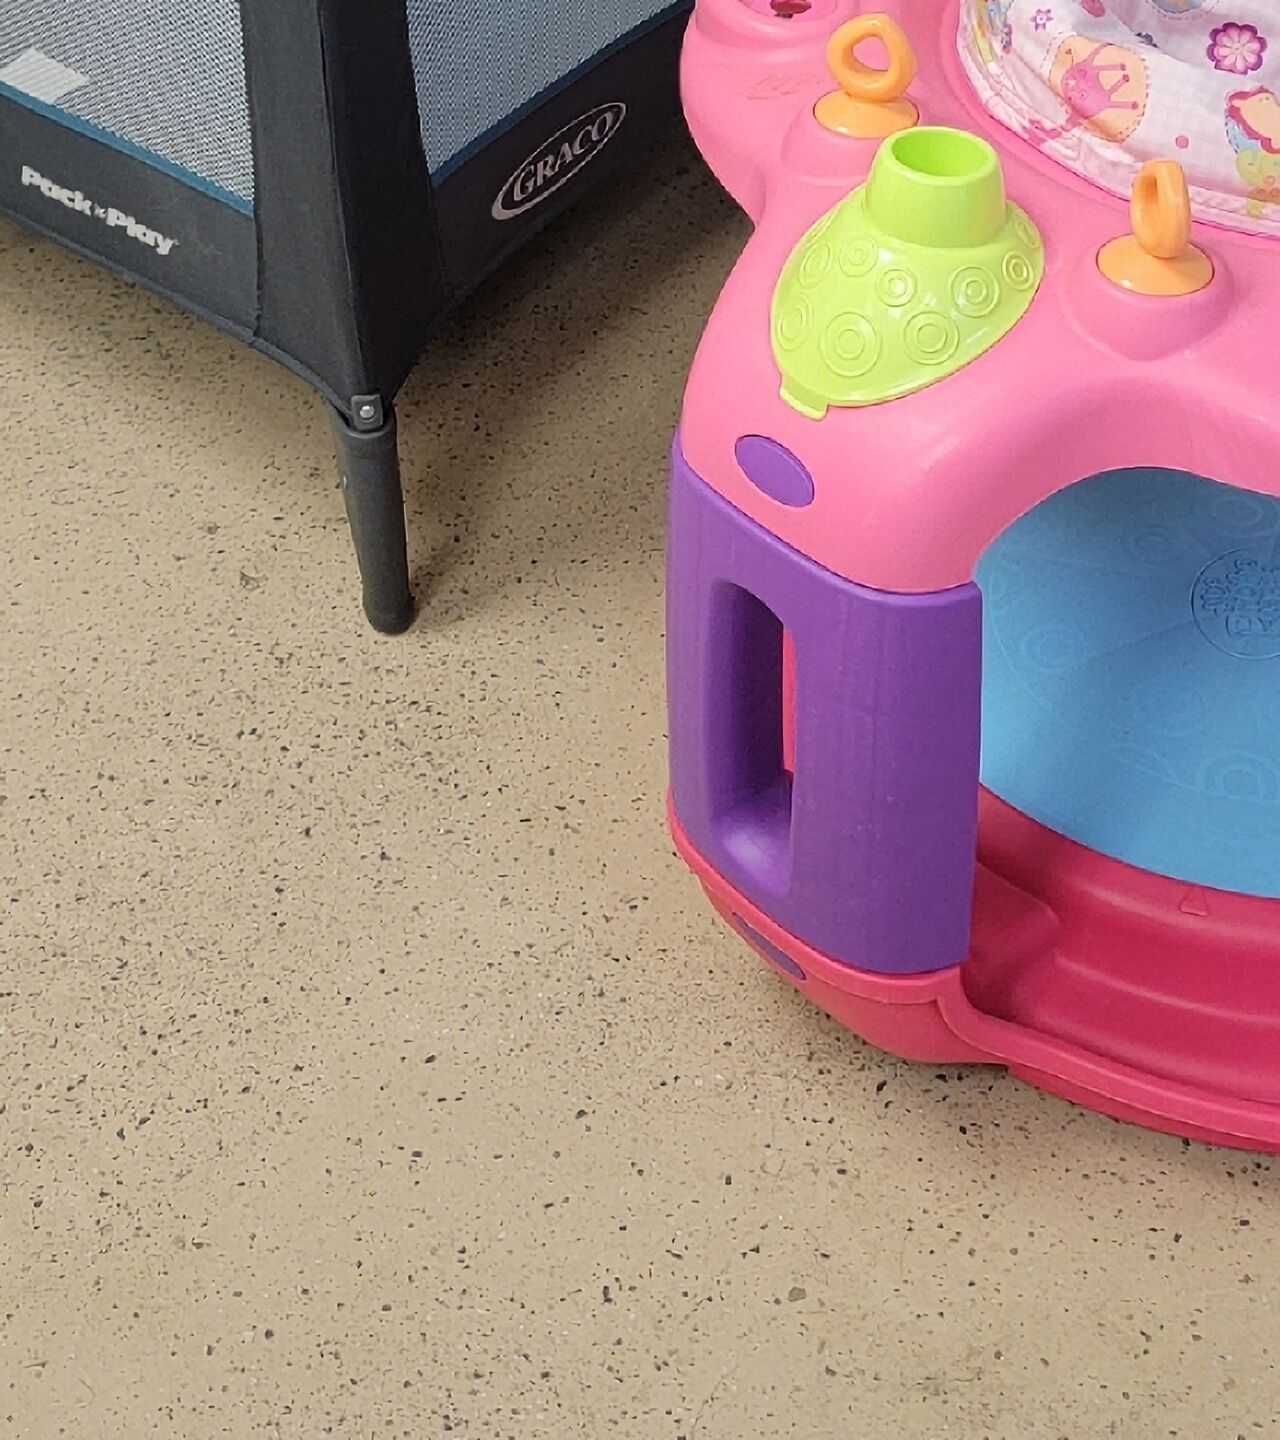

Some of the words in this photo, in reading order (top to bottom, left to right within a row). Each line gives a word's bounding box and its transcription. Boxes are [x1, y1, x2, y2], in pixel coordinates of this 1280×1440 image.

[513, 112, 616, 201] GRACO
[21, 165, 92, 216] Pack
[106, 207, 175, 256] Play
